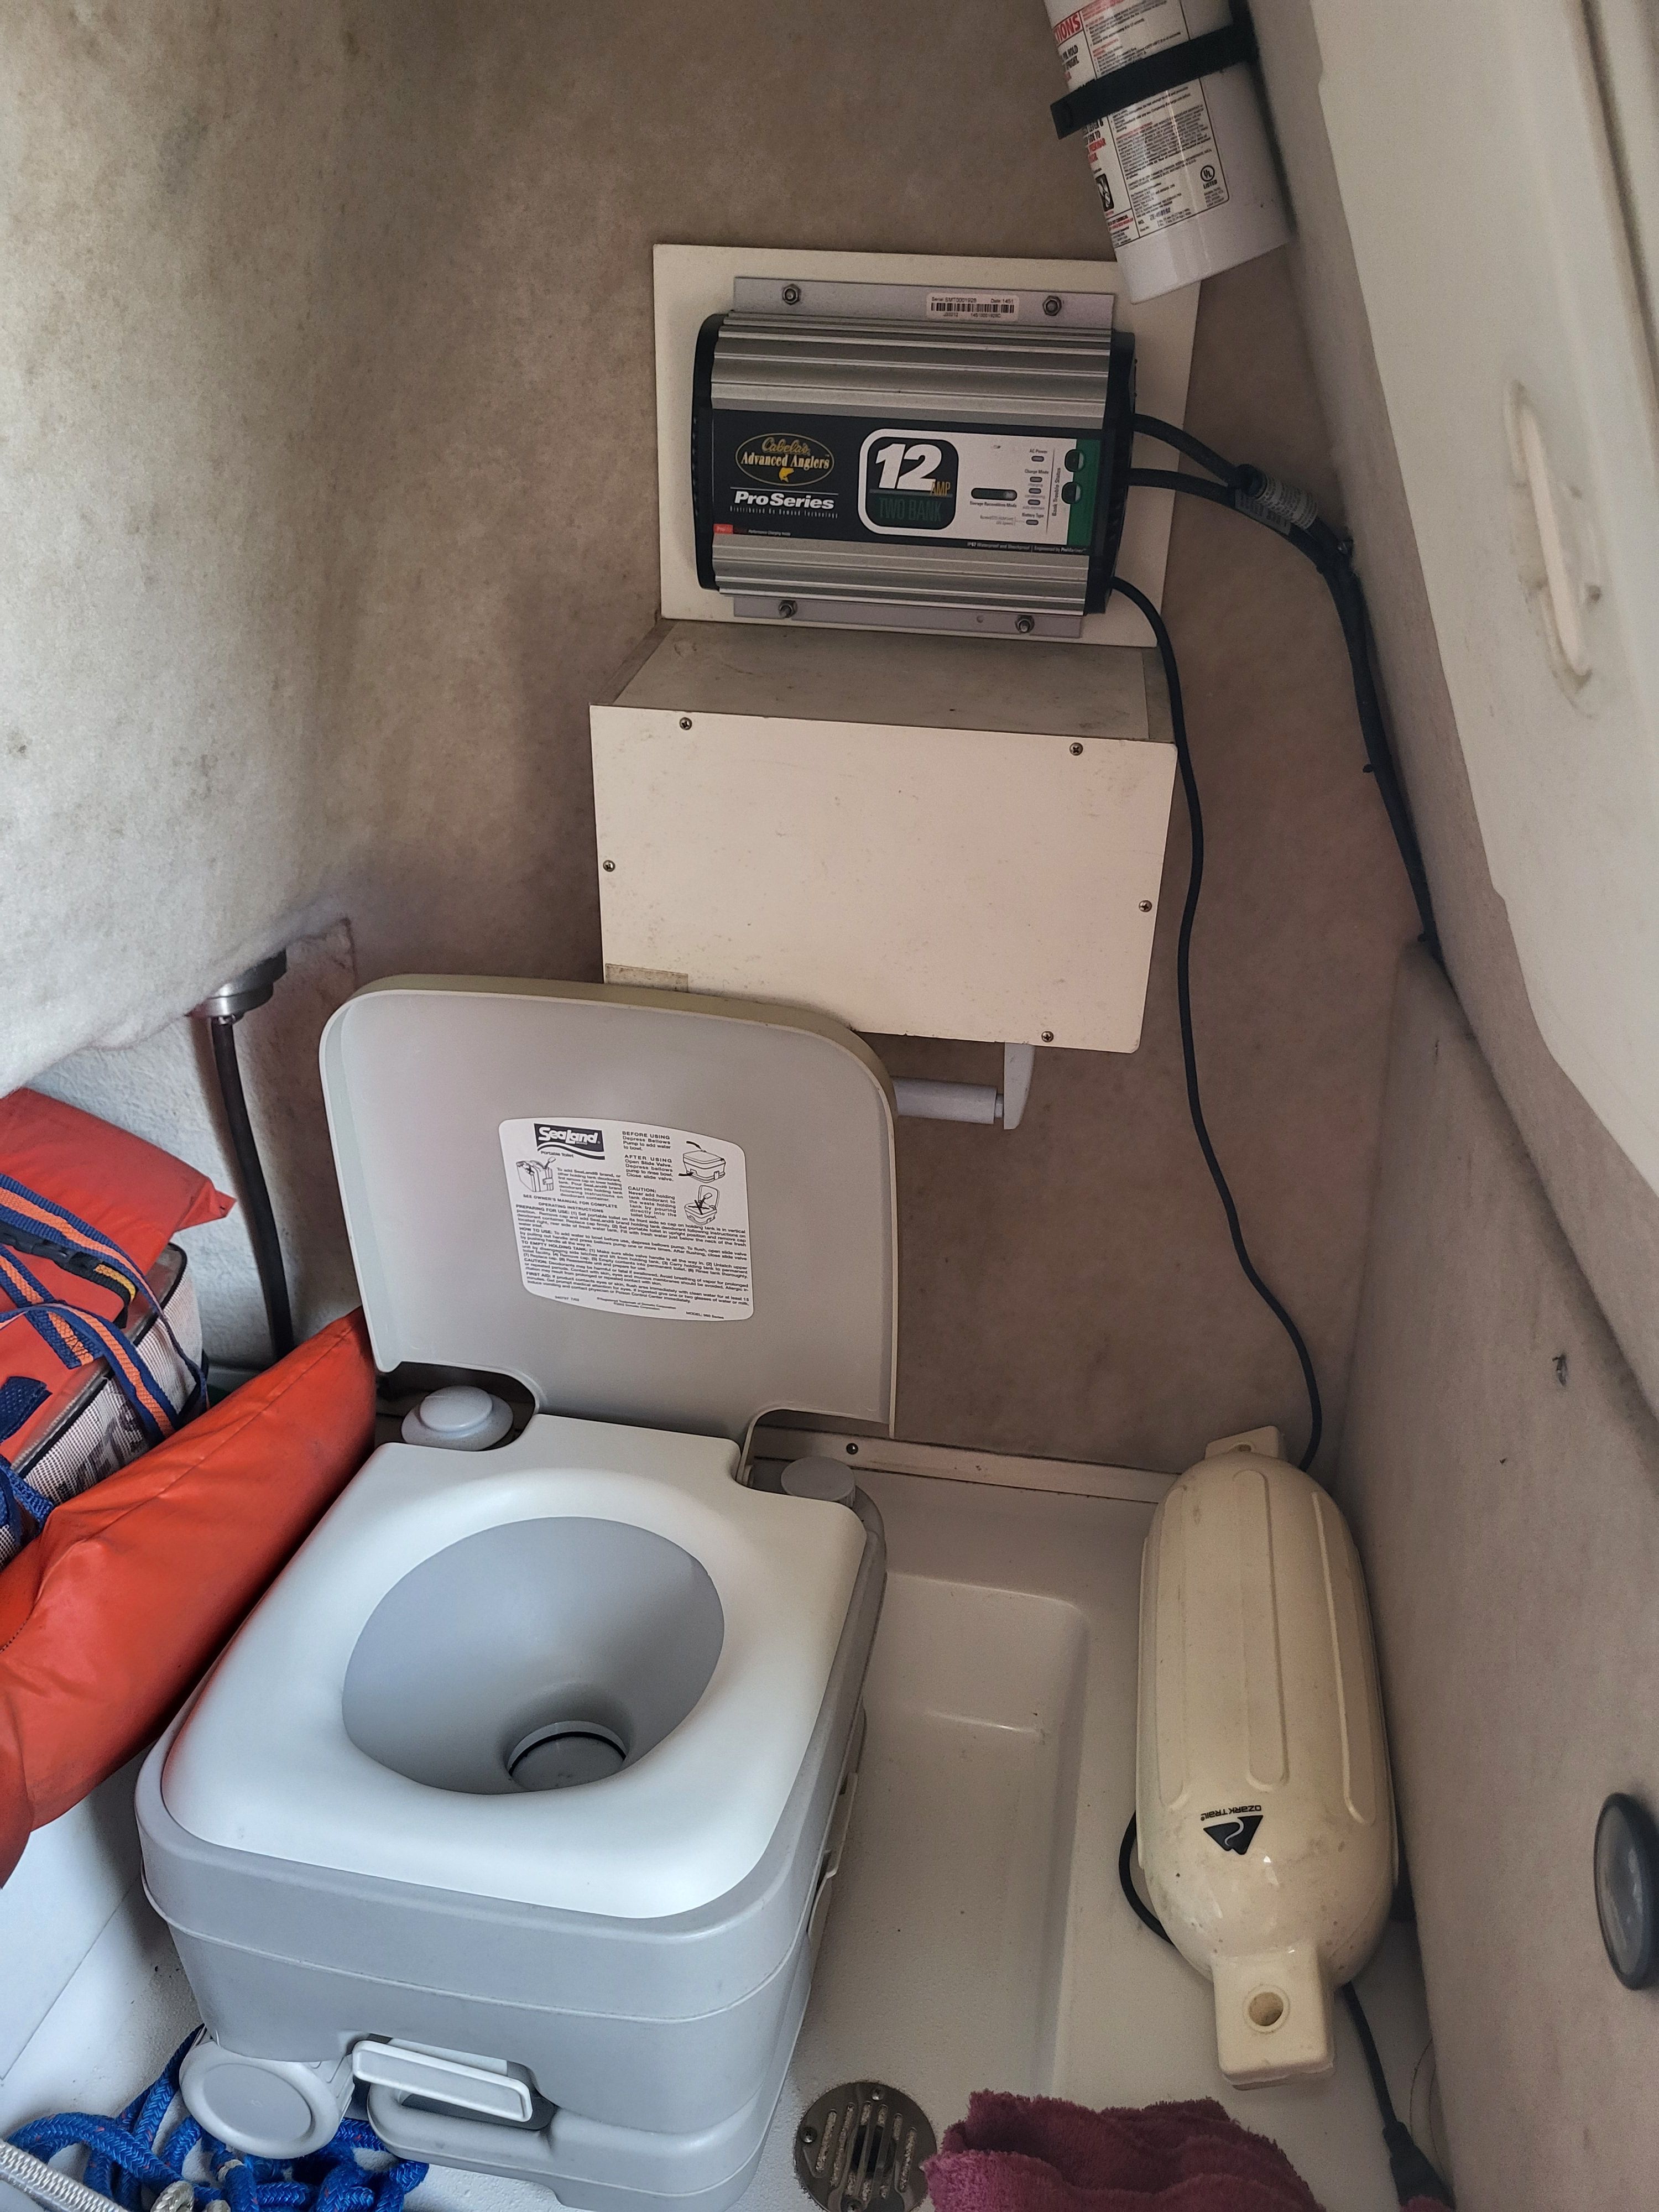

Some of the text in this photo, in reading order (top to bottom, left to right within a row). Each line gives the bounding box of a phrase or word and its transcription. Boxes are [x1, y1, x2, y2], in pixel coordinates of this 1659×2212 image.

[1203, 180, 1217, 189] LISTED
[761, 437, 810, 455] Cabela's
[741, 452, 830, 471] Advanced Anglers
[875, 443, 942, 491] 12
[930, 481, 951, 496] AMP
[909, 499, 941, 522] BANK
